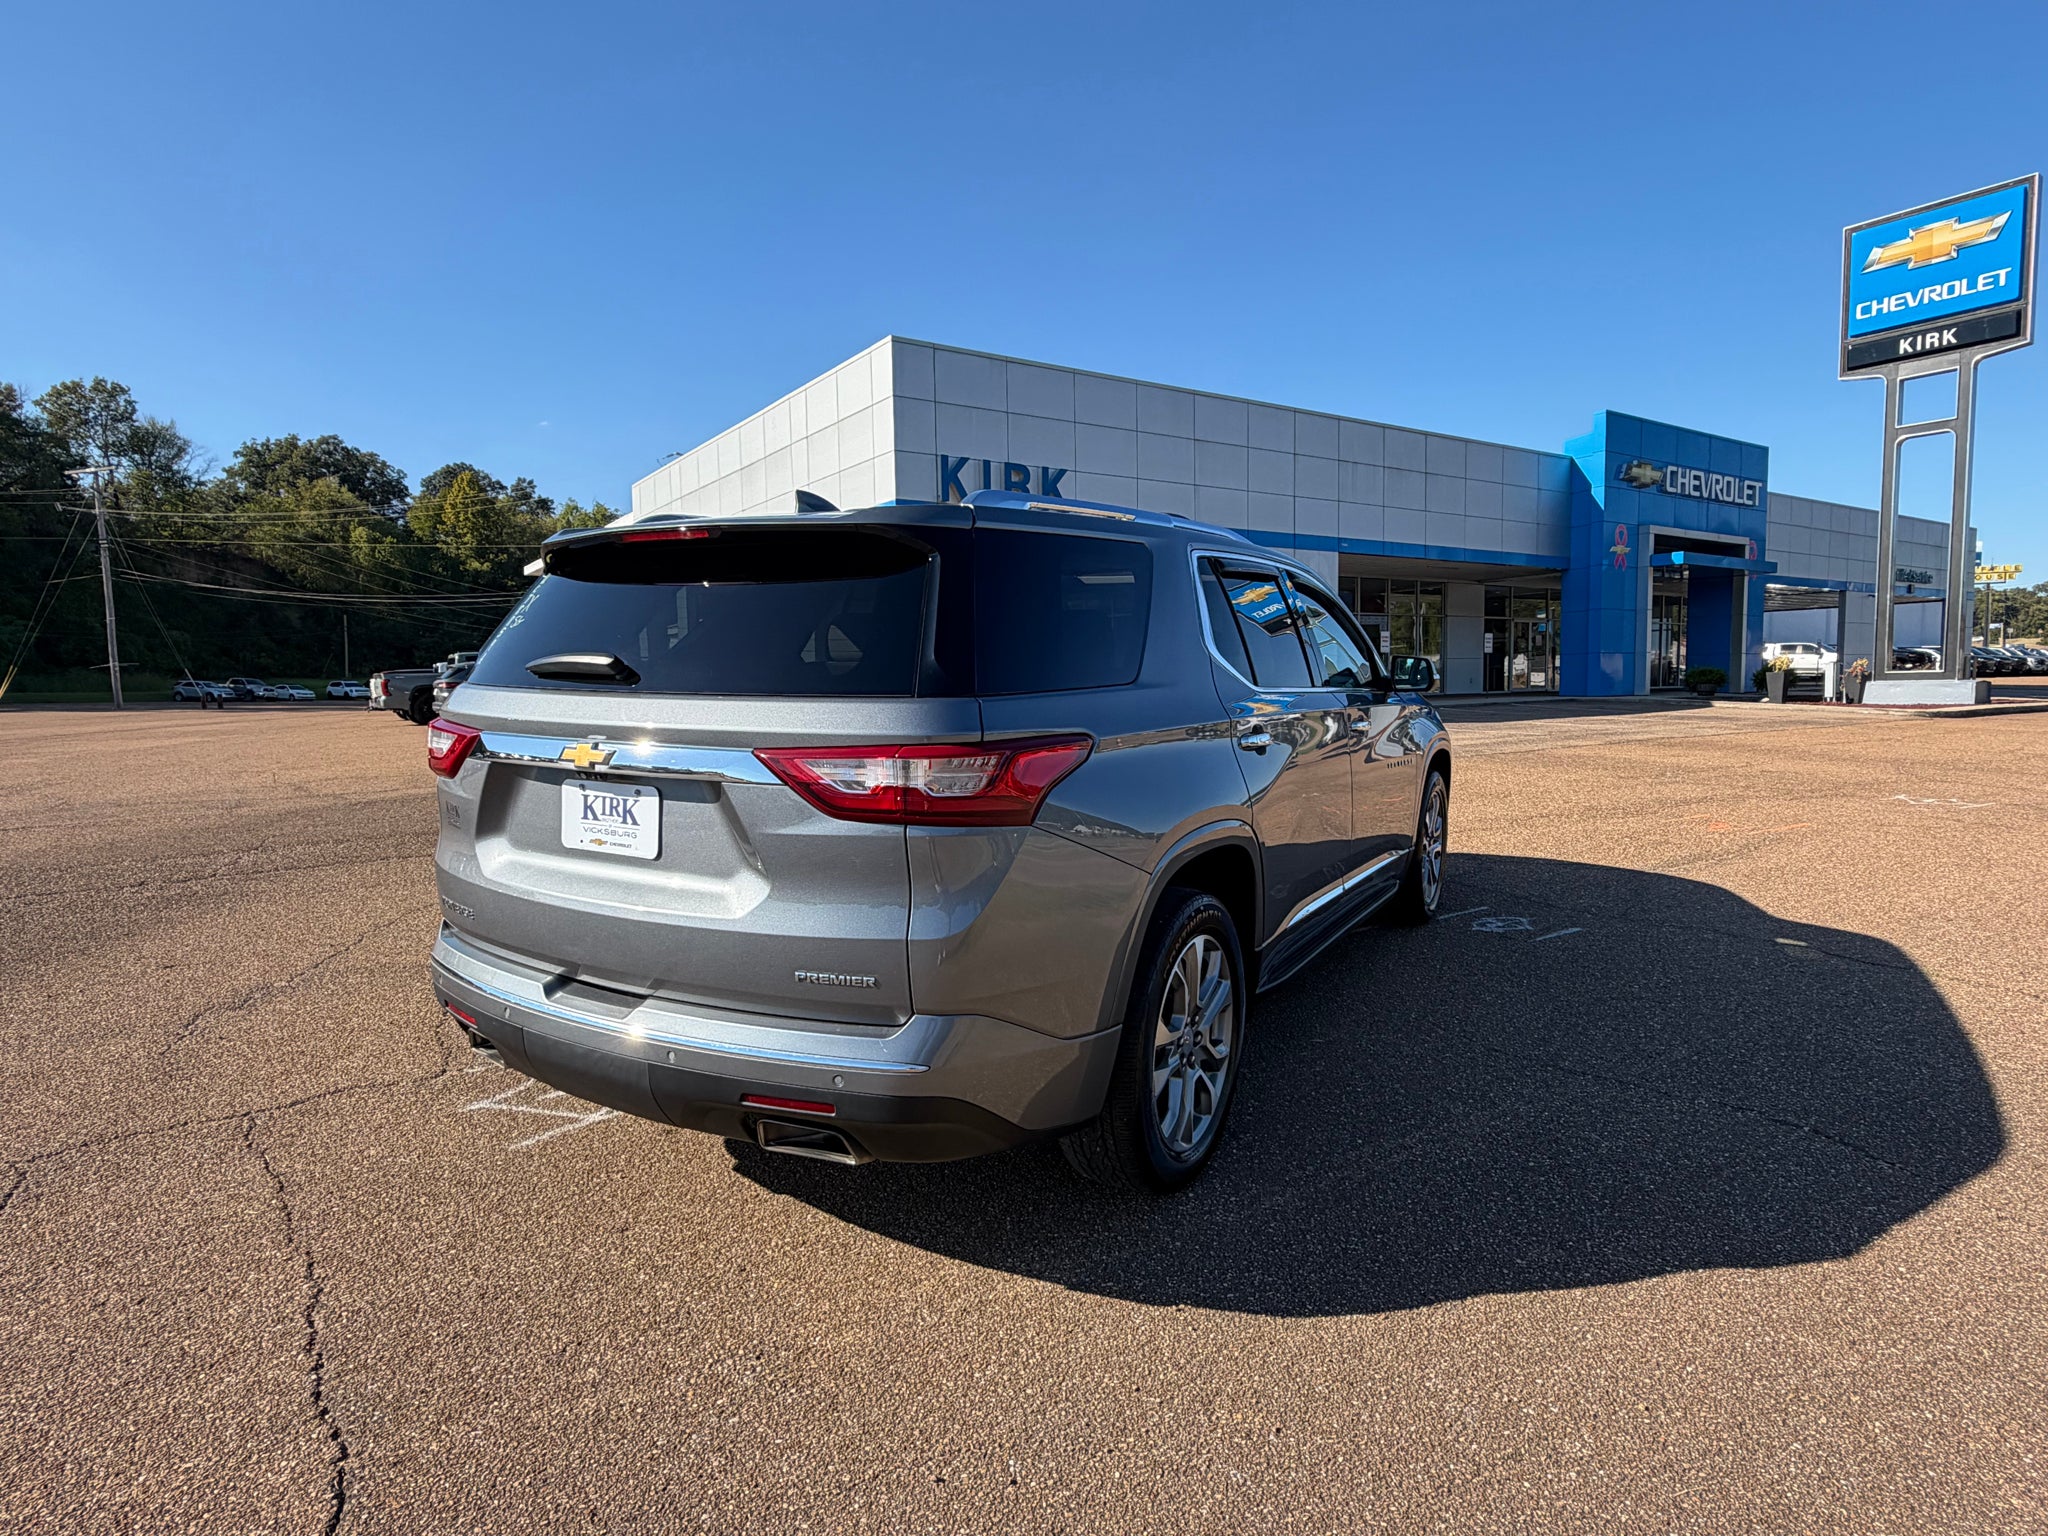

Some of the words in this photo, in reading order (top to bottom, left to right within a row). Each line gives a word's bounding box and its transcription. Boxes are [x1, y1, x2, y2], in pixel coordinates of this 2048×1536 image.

[1855, 267, 2012, 320] CHEVROLET
[1899, 328, 1957, 354] KIRK
[941, 454, 1068, 502] KIRK
[1665, 465, 1762, 506] CHEVROLET
[581, 793, 640, 826] KIRK
[582, 825, 638, 839] VICKSBURG
[794, 971, 876, 988] PREMIER
